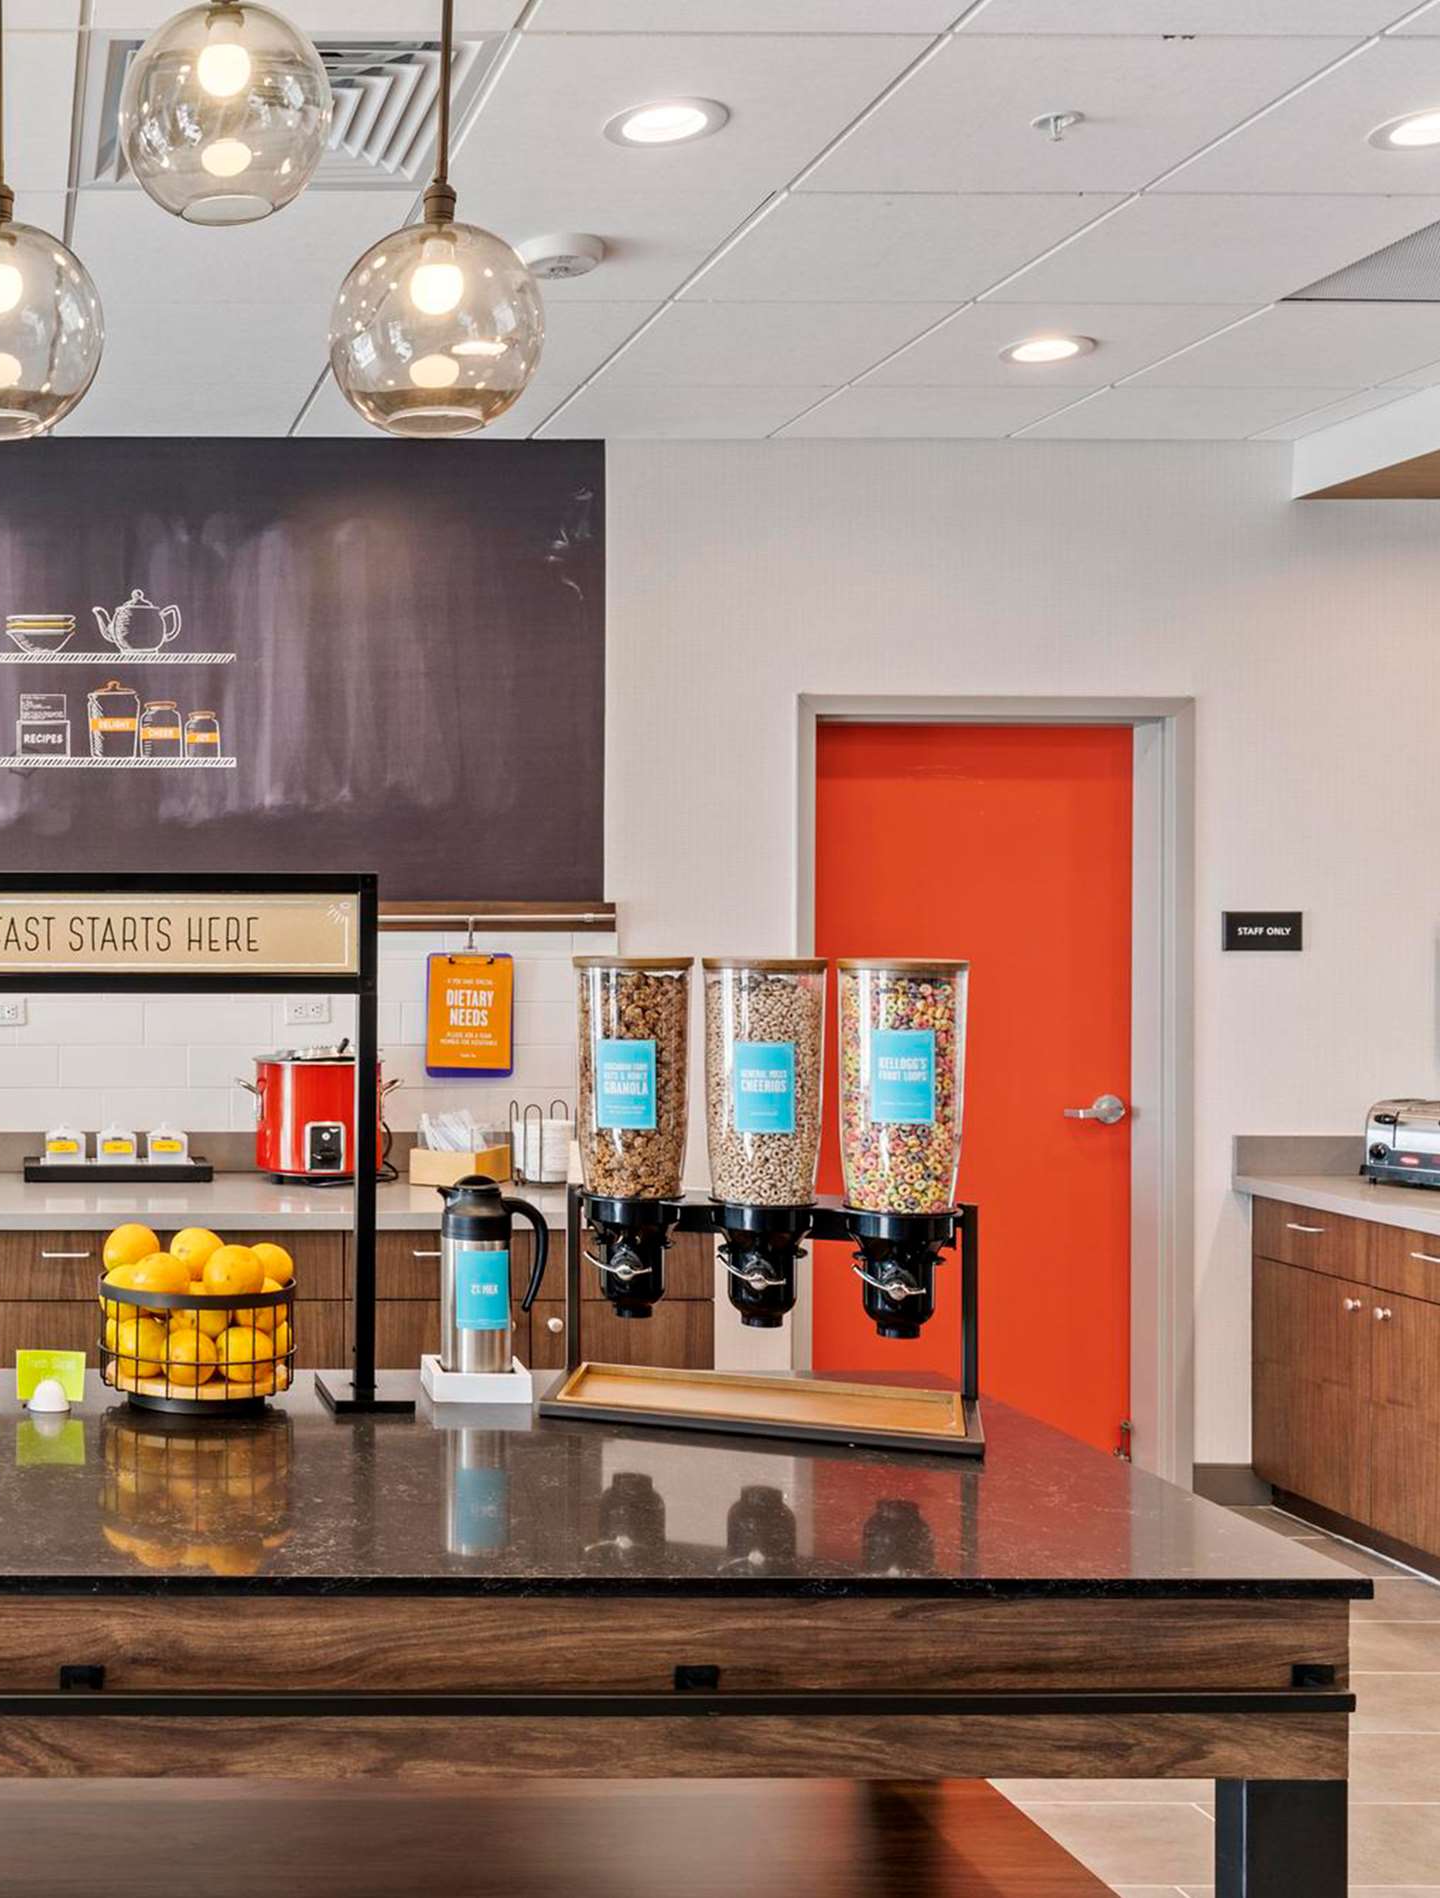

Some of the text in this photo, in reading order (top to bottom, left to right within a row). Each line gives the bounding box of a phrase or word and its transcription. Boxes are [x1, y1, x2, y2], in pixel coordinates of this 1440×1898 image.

[23, 733, 64, 744] RECIPES
[68, 916, 172, 952] STARTS
[187, 916, 260, 952] HERE
[1237, 927, 1292, 936] STAFF ONLY
[446, 989, 495, 1008] DIETARY
[450, 1008, 489, 1027] NEEDS
[879, 1056, 929, 1070] KELLOGG'S
[604, 1080, 649, 1096] GRANOLA
[741, 1079, 787, 1093] CHEERIOS
